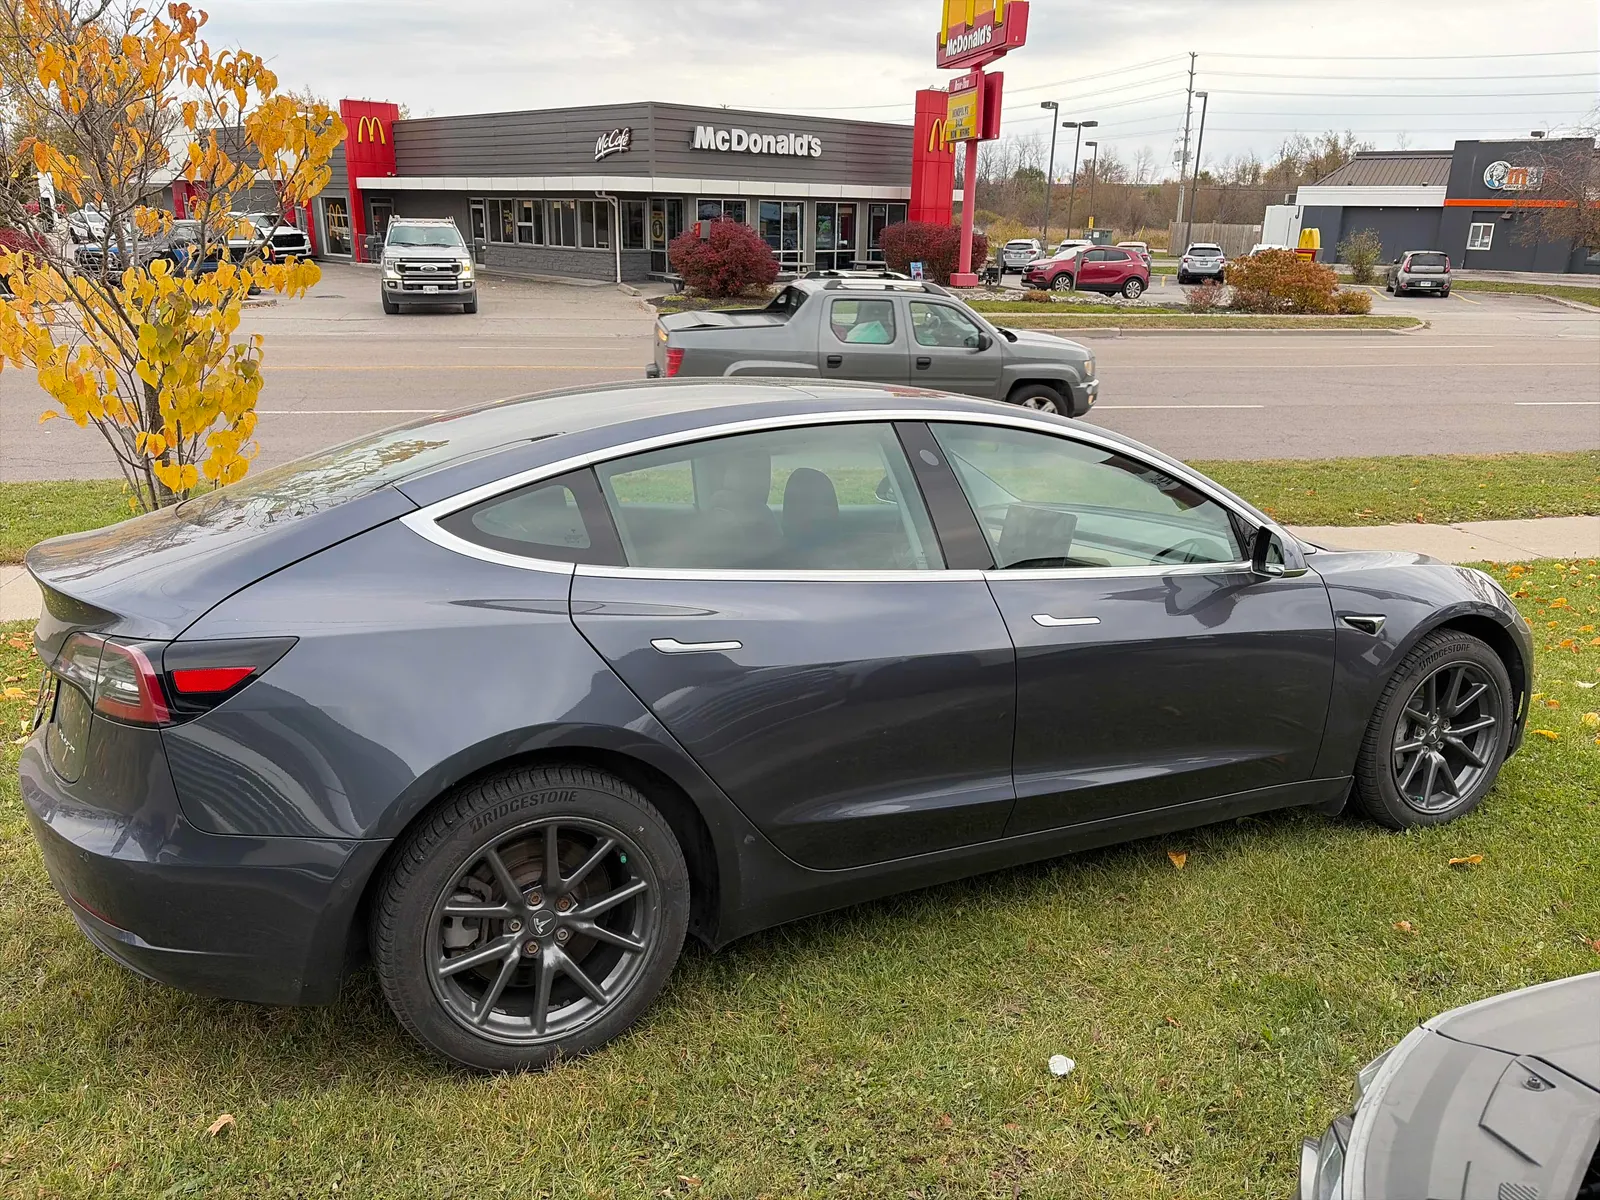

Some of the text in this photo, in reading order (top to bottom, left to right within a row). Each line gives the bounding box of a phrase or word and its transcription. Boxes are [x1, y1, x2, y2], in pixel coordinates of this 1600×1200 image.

[946, 24, 993, 57] McDonald's
[594, 127, 630, 159] McCafé
[693, 126, 822, 158] McDonald's
[1419, 643, 1471, 671] BRIDGESTONE
[469, 790, 579, 834] BRIDGESTONE
